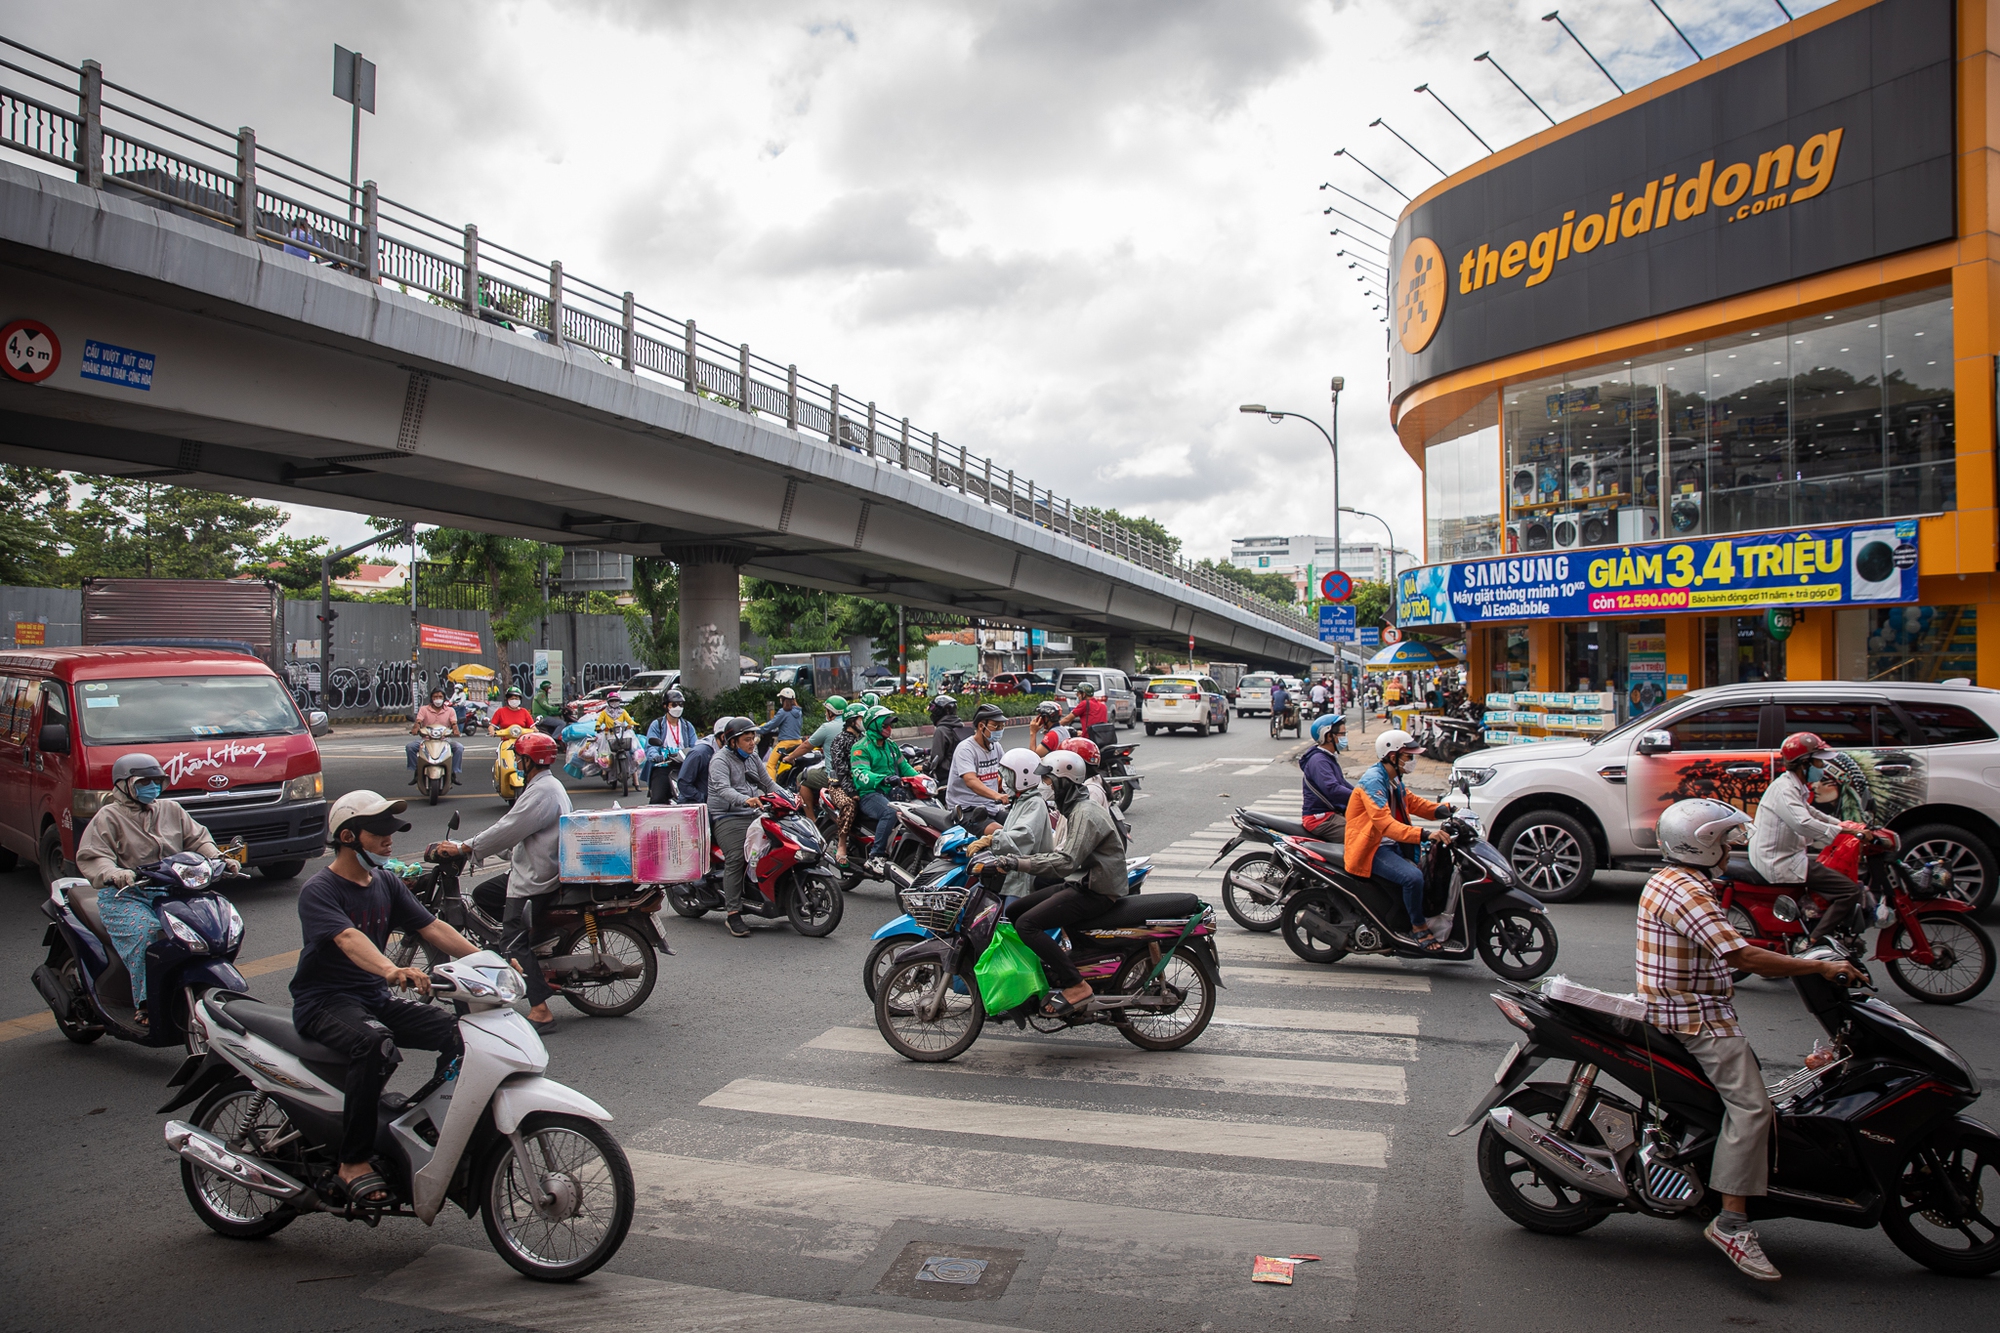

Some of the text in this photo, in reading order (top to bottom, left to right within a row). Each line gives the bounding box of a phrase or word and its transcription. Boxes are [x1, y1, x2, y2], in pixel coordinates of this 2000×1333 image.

[1459, 127, 1844, 294] thegioididong
[1728, 194, 1786, 222] .com
[1464, 556, 1569, 588] SAMSUNG
[1588, 532, 1843, 588] GIẢM 3.4 TRIỆU
[1453, 591, 1472, 606] Máy
[1474, 588, 1494, 606] giặt
[1496, 586, 1526, 604] thông
[1527, 584, 1559, 599] minh
[1493, 600, 1550, 616] EcoBubble
[1593, 592, 1687, 610] còn 12.590.000
